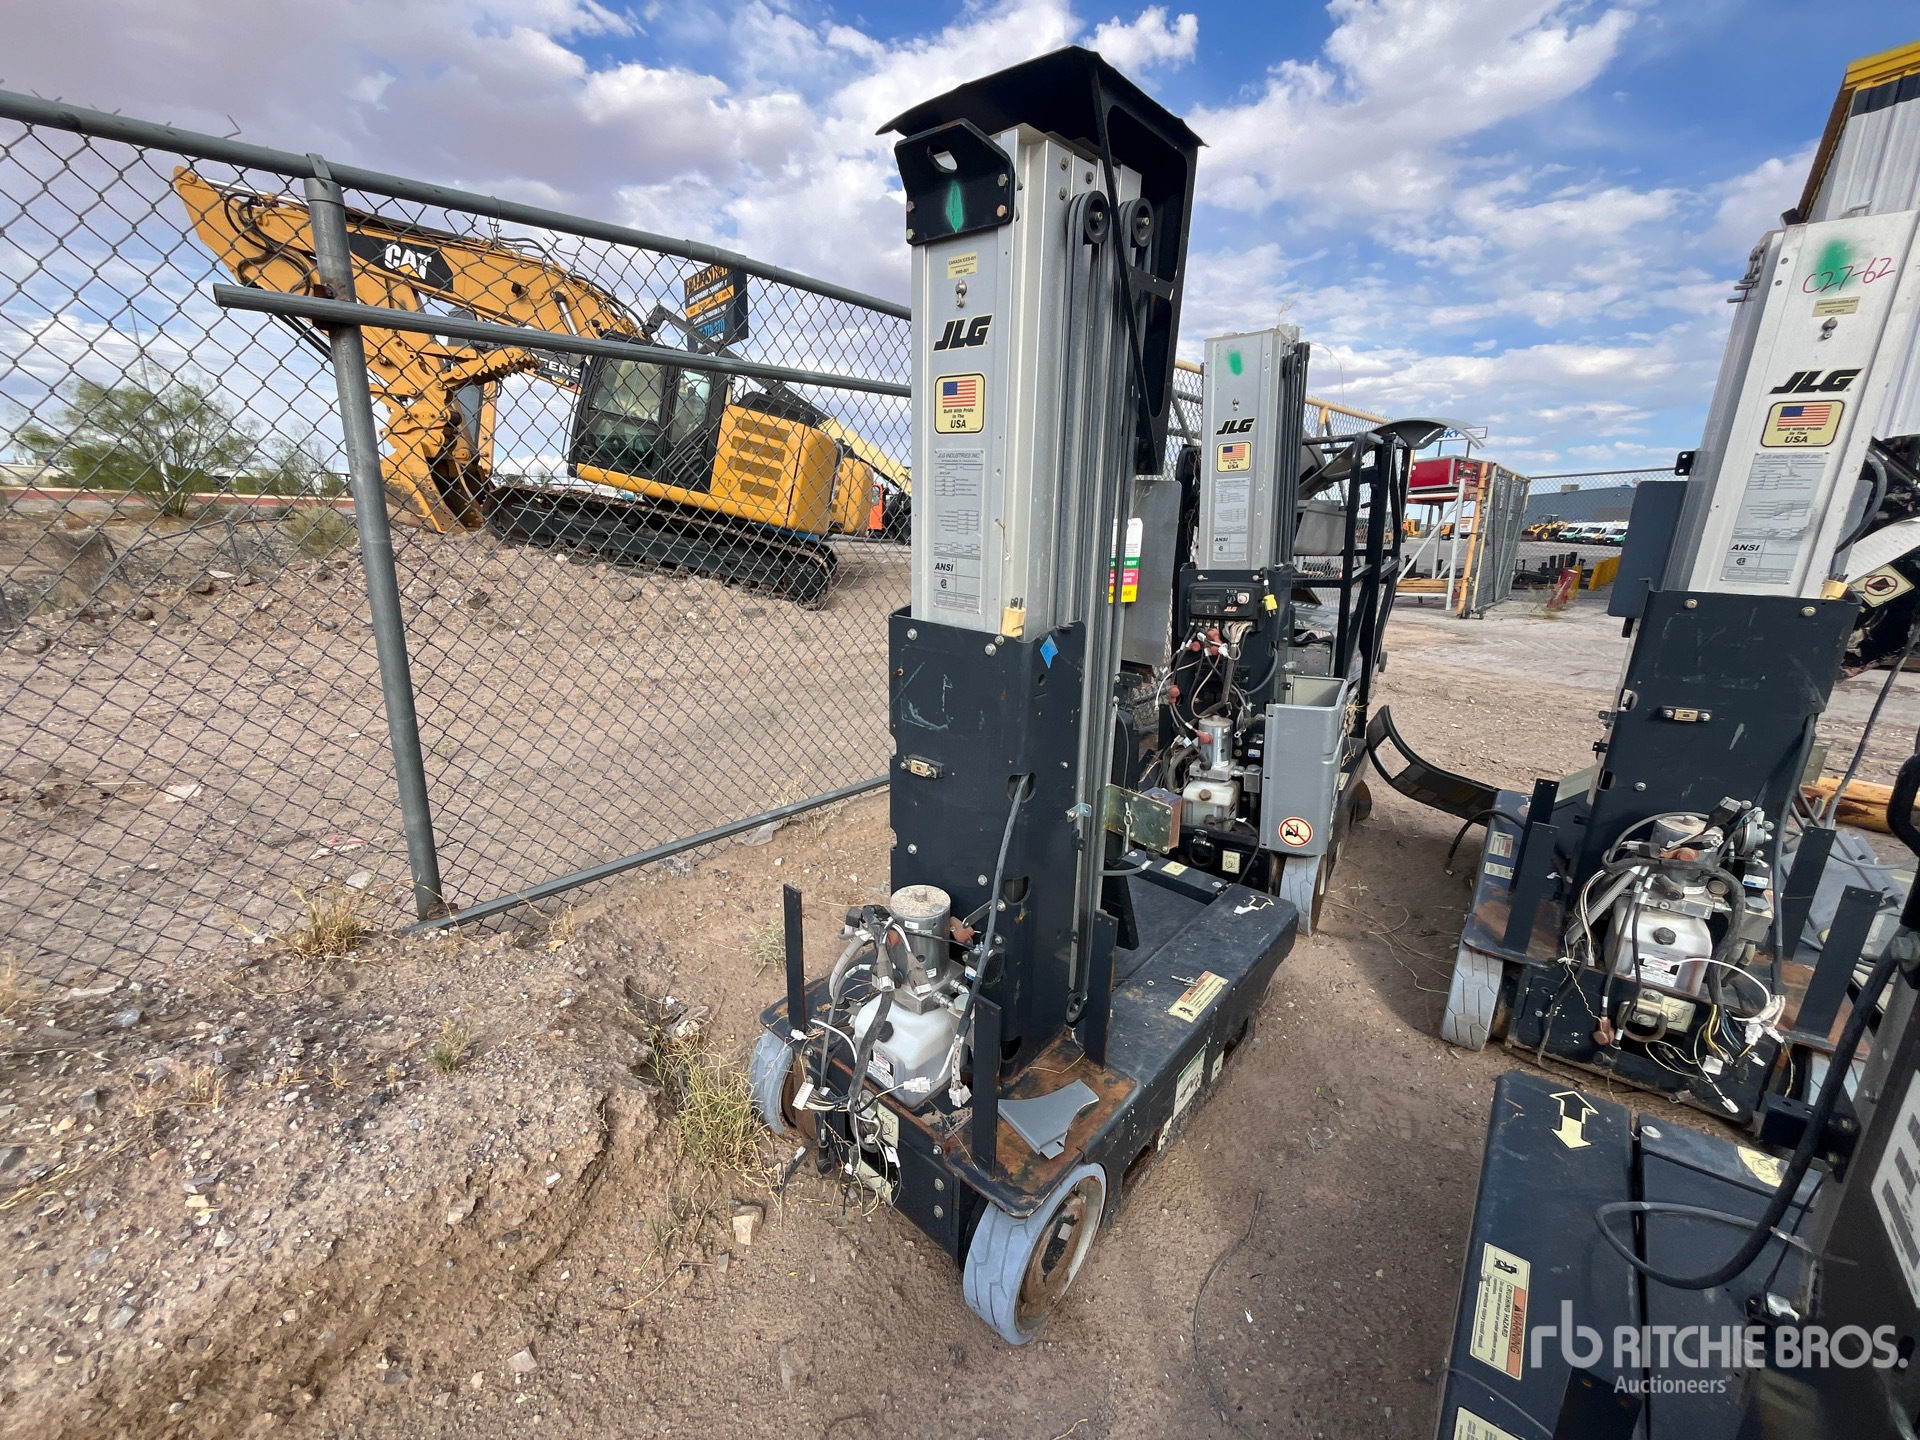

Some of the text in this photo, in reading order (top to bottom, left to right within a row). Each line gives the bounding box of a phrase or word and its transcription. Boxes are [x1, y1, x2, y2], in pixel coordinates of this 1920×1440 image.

[384, 243, 432, 280] CAT
[1802, 257, 1896, 294] C27-62
[933, 314, 993, 351] JLG
[1768, 368, 1863, 395] JLG
[950, 419, 967, 429] USA
[1215, 417, 1256, 435] JLG
[1784, 435, 1808, 444] USA
[1730, 543, 1761, 552] ANSI
[934, 562, 954, 572] ANSI
[1501, 1284, 1513, 1338] CRUSHING HAZARD
[1510, 1309, 1524, 1355] WARNING
